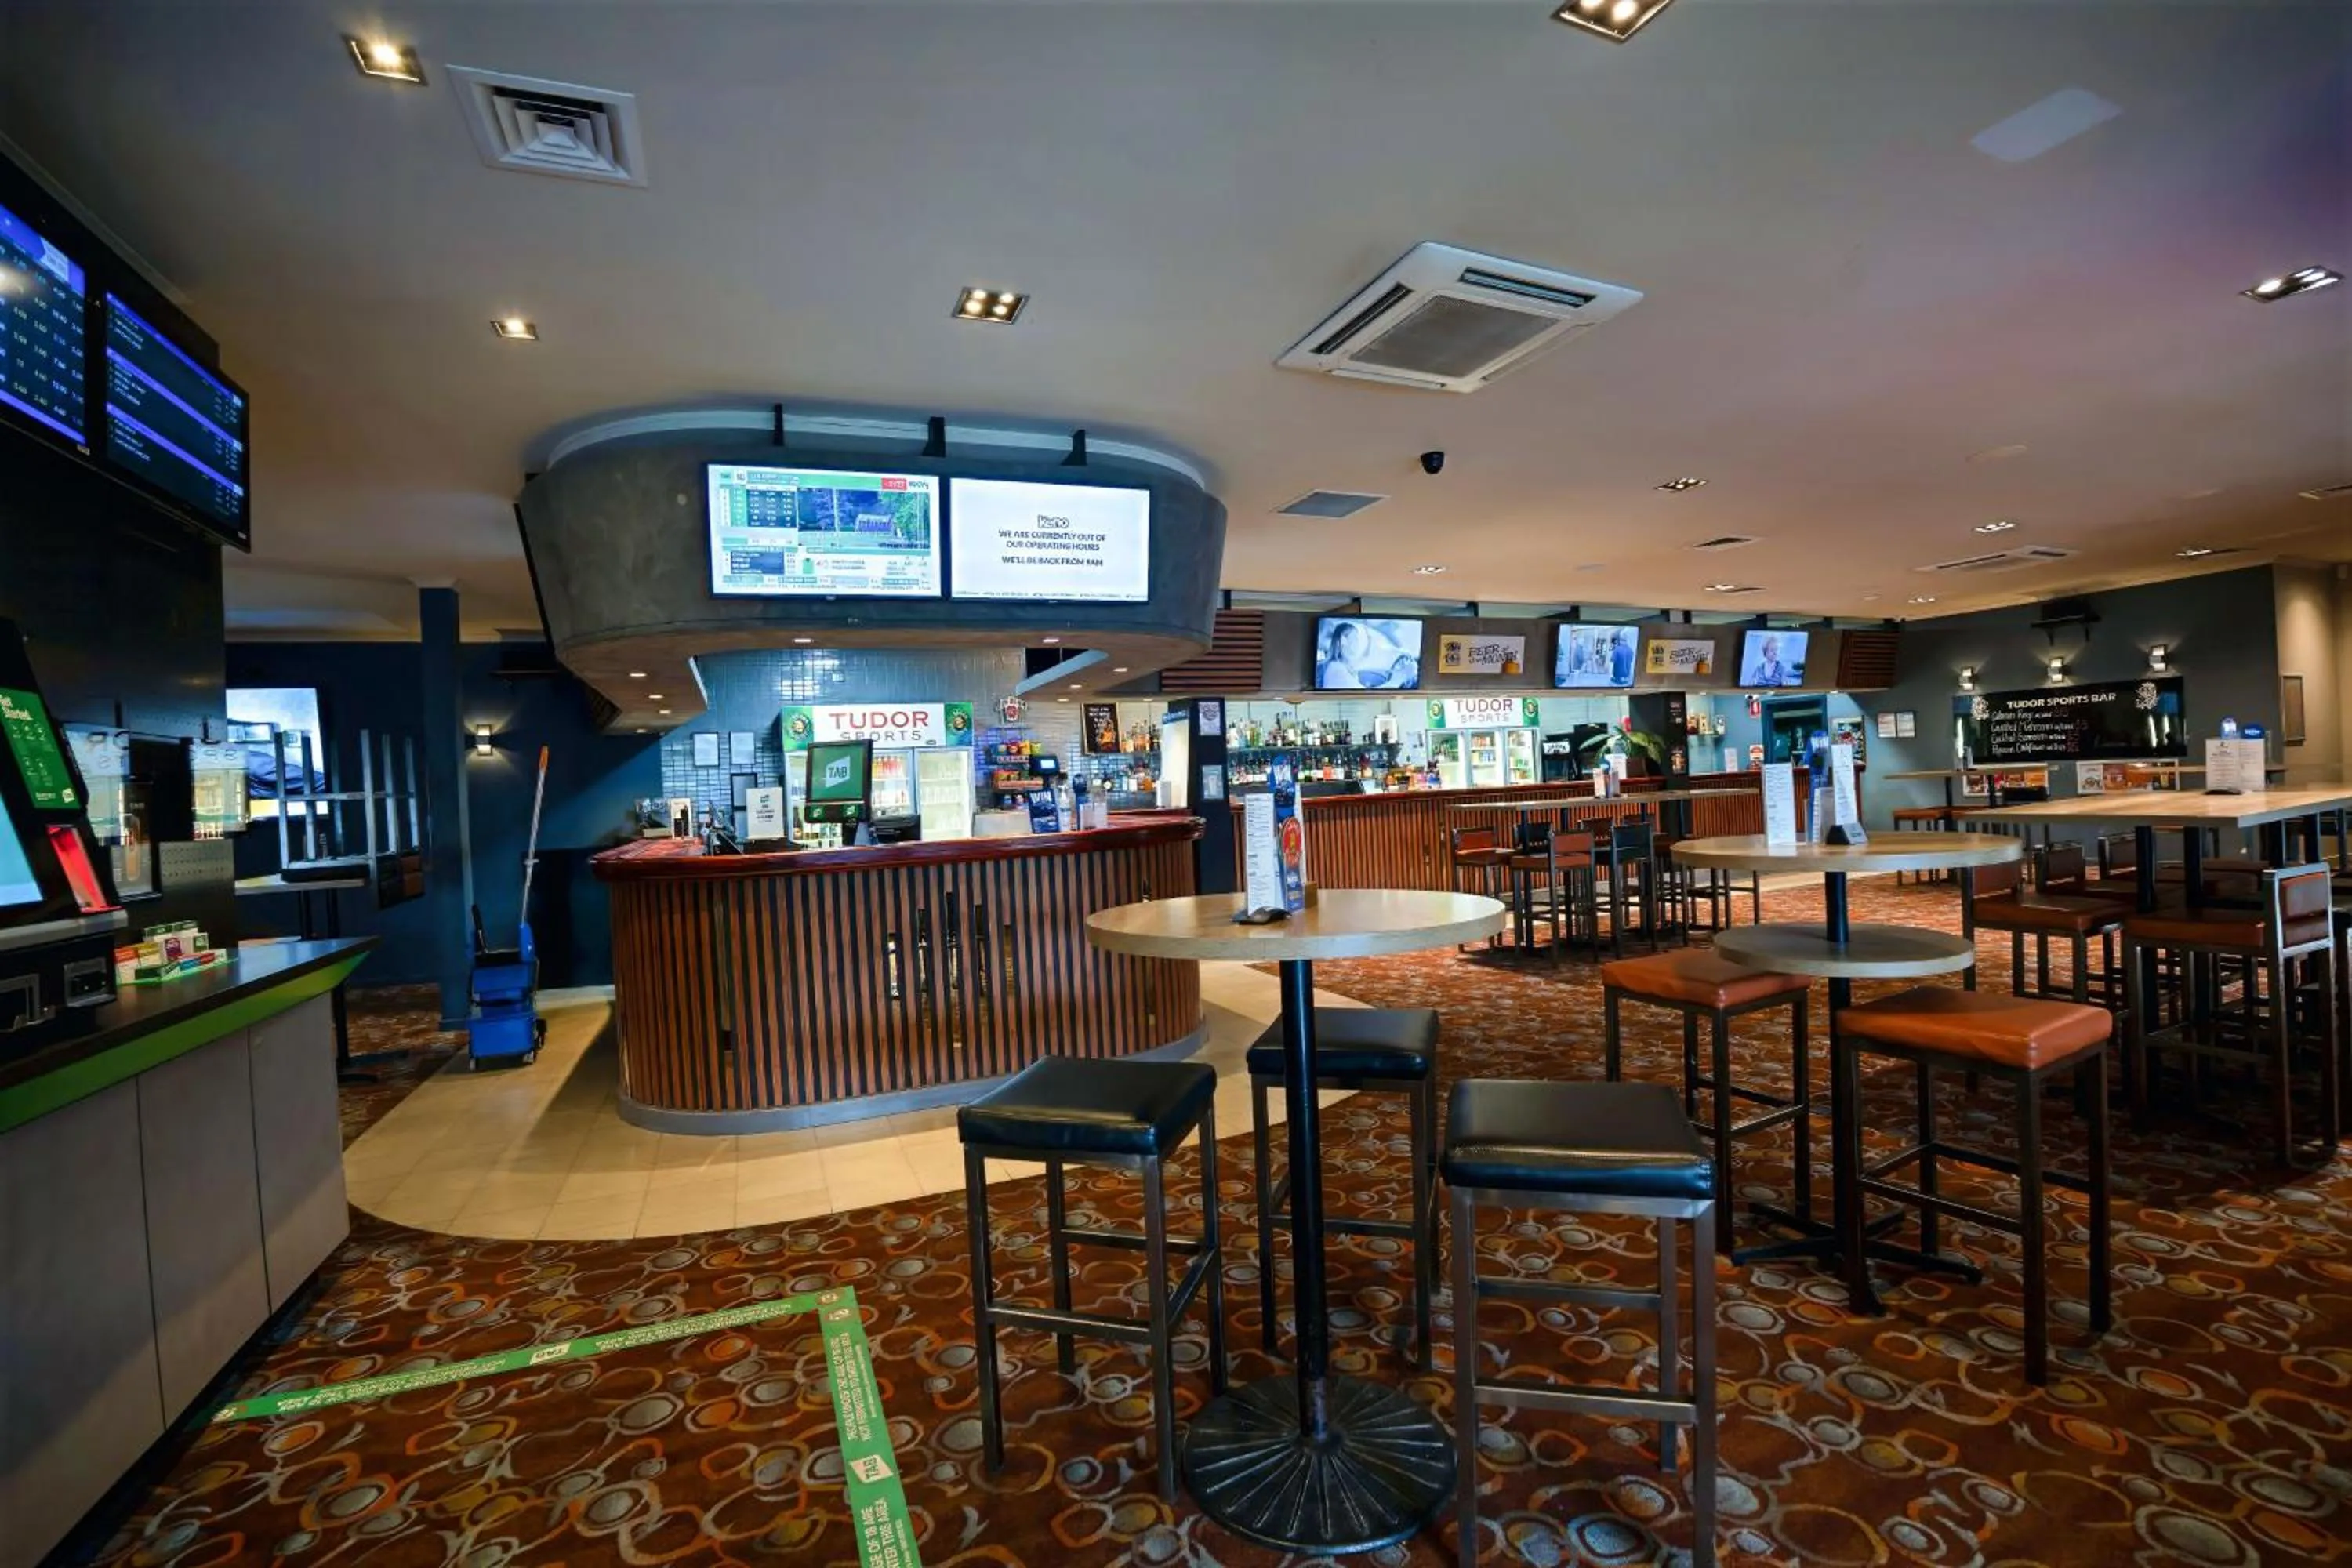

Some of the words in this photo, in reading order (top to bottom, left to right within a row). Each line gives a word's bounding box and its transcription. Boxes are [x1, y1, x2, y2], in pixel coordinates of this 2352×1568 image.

[1031, 531, 1076, 540] CURRENTLY
[1025, 541, 1071, 550] OPERATING
[1454, 699, 1513, 713] TUDOR
[2007, 699, 2045, 709] TUDOR
[2046, 695, 2089, 706] SPORTS
[2091, 692, 2117, 702] BAR
[829, 711, 929, 730] TUDOR
[1461, 713, 1510, 724] SPORTS
[840, 730, 922, 742] SPORTS
[828, 766, 848, 779] TAB
[1029, 791, 1052, 804] WIN
[863, 1457, 879, 1479] TAB
[859, 1505, 876, 1526] ARE
[873, 1496, 890, 1523] AREA
[878, 1523, 895, 1547] THIS
[866, 1537, 880, 1553] OF
